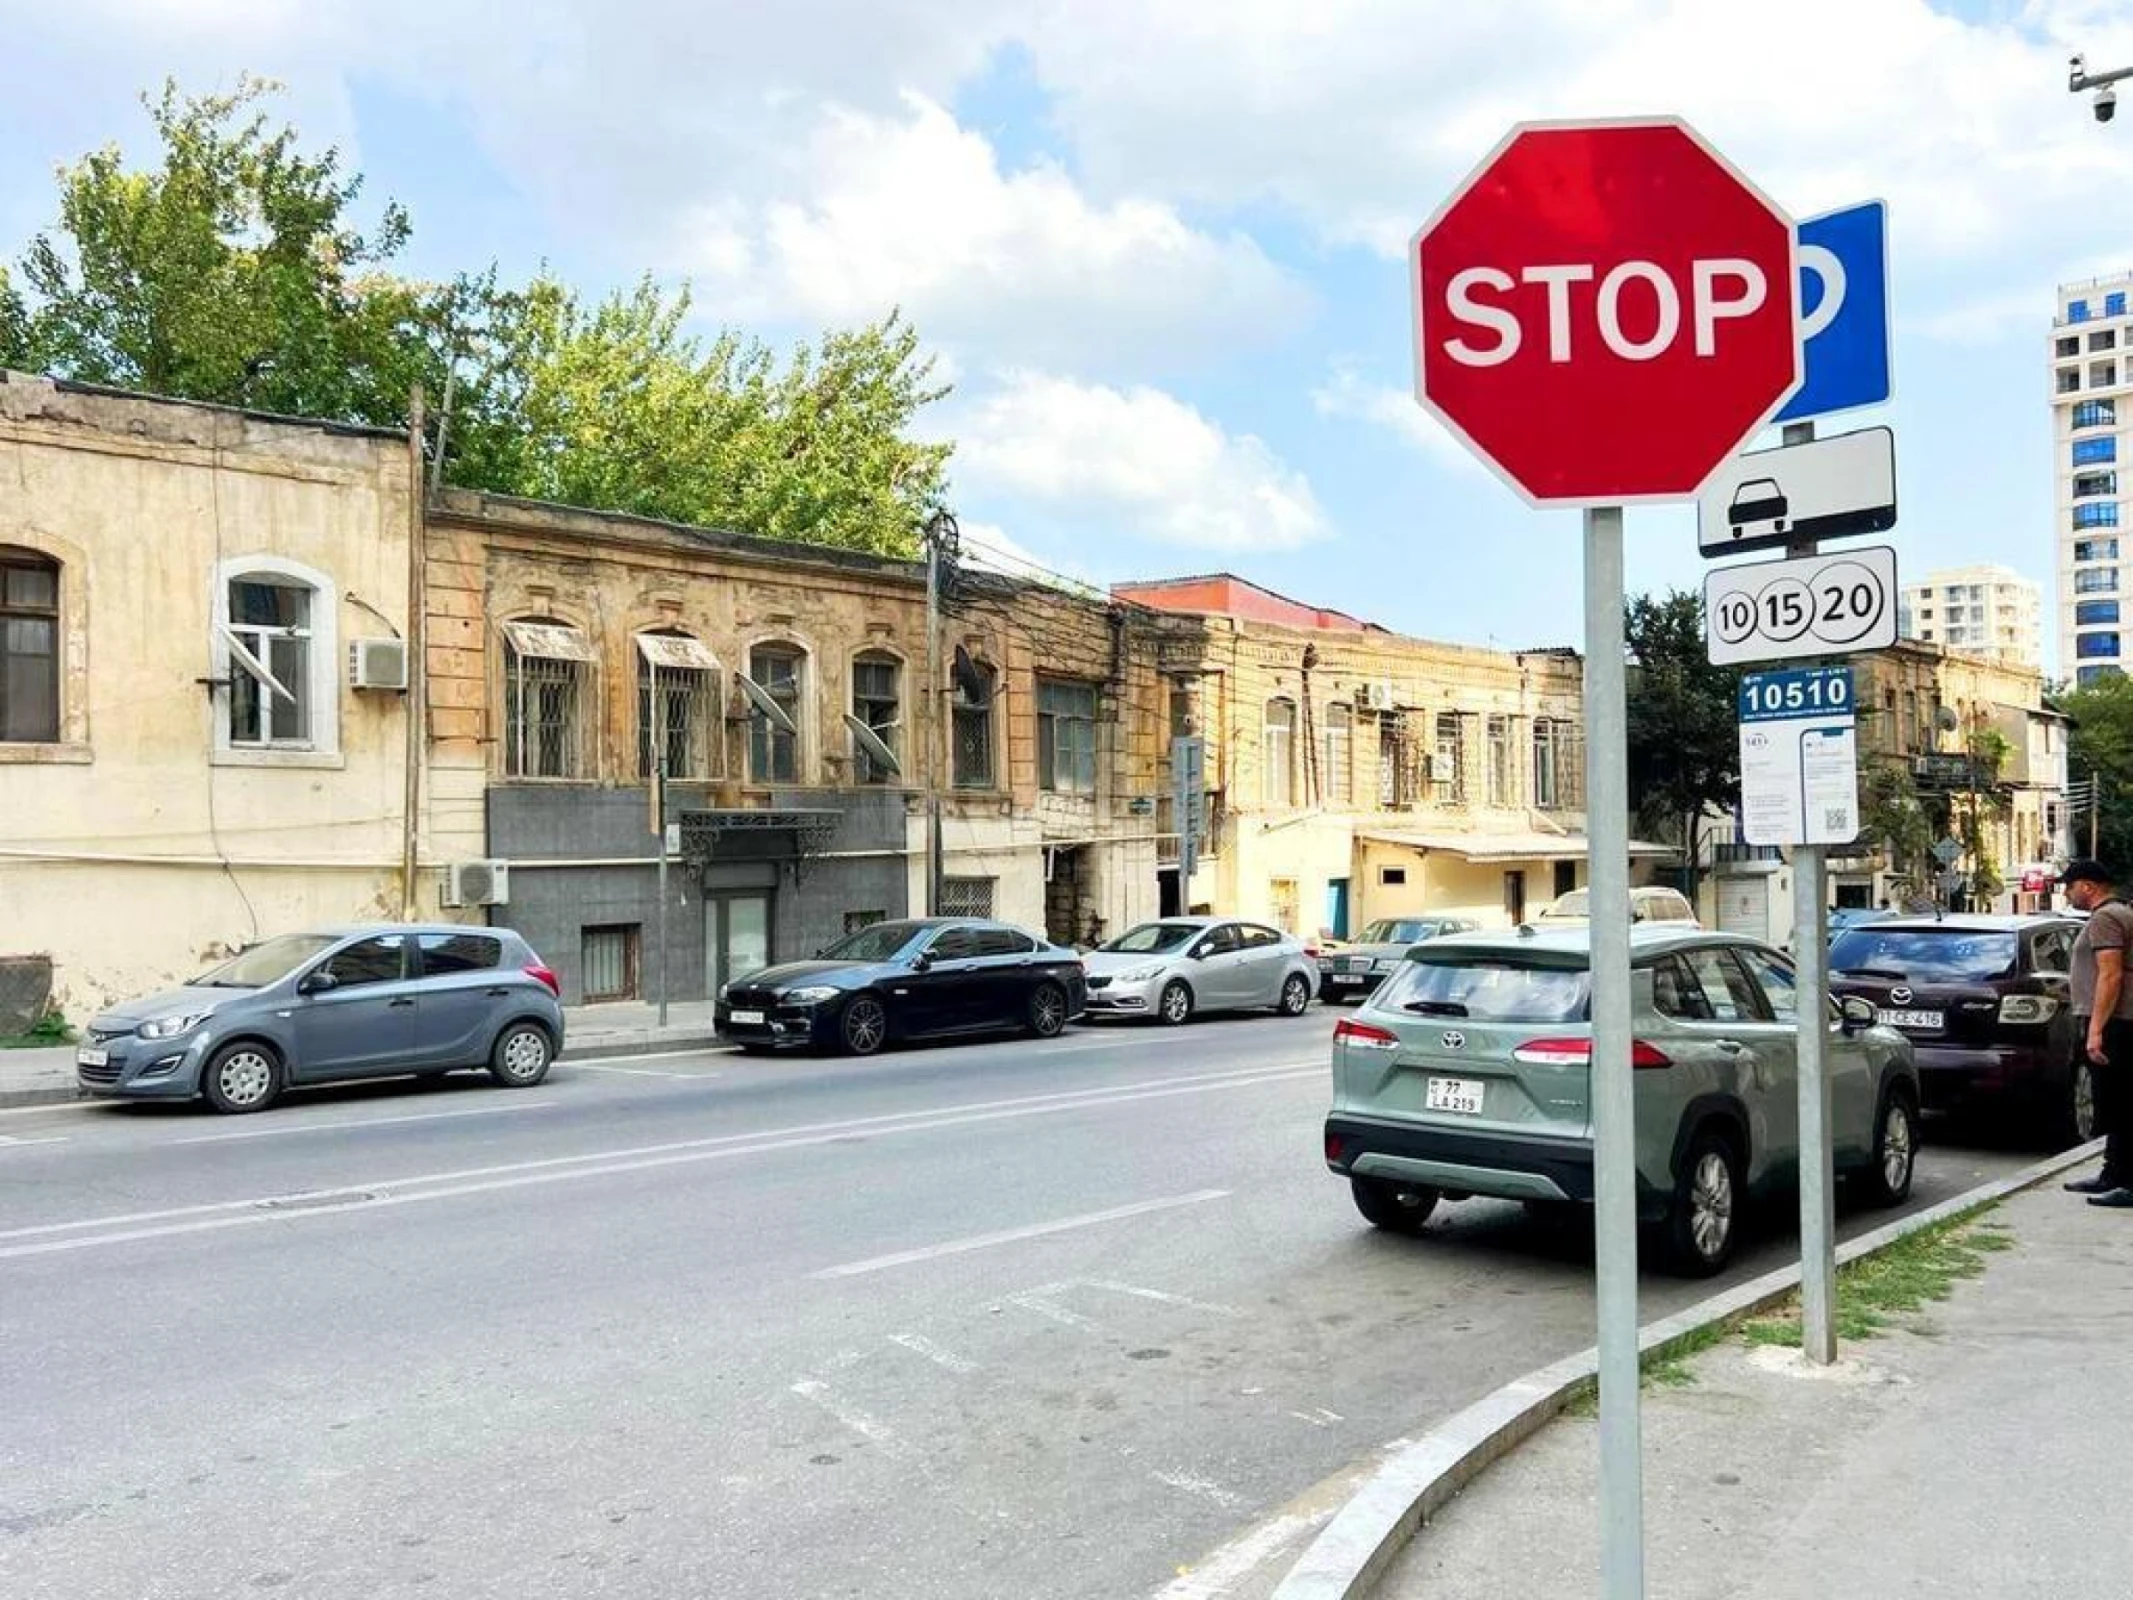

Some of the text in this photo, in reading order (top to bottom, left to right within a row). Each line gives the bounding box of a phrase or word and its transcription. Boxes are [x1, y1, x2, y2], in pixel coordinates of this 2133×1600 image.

[1442, 258, 1768, 367] STOP
[1720, 582, 1873, 632] 10 15 20
[1745, 678, 1847, 711] 10510
